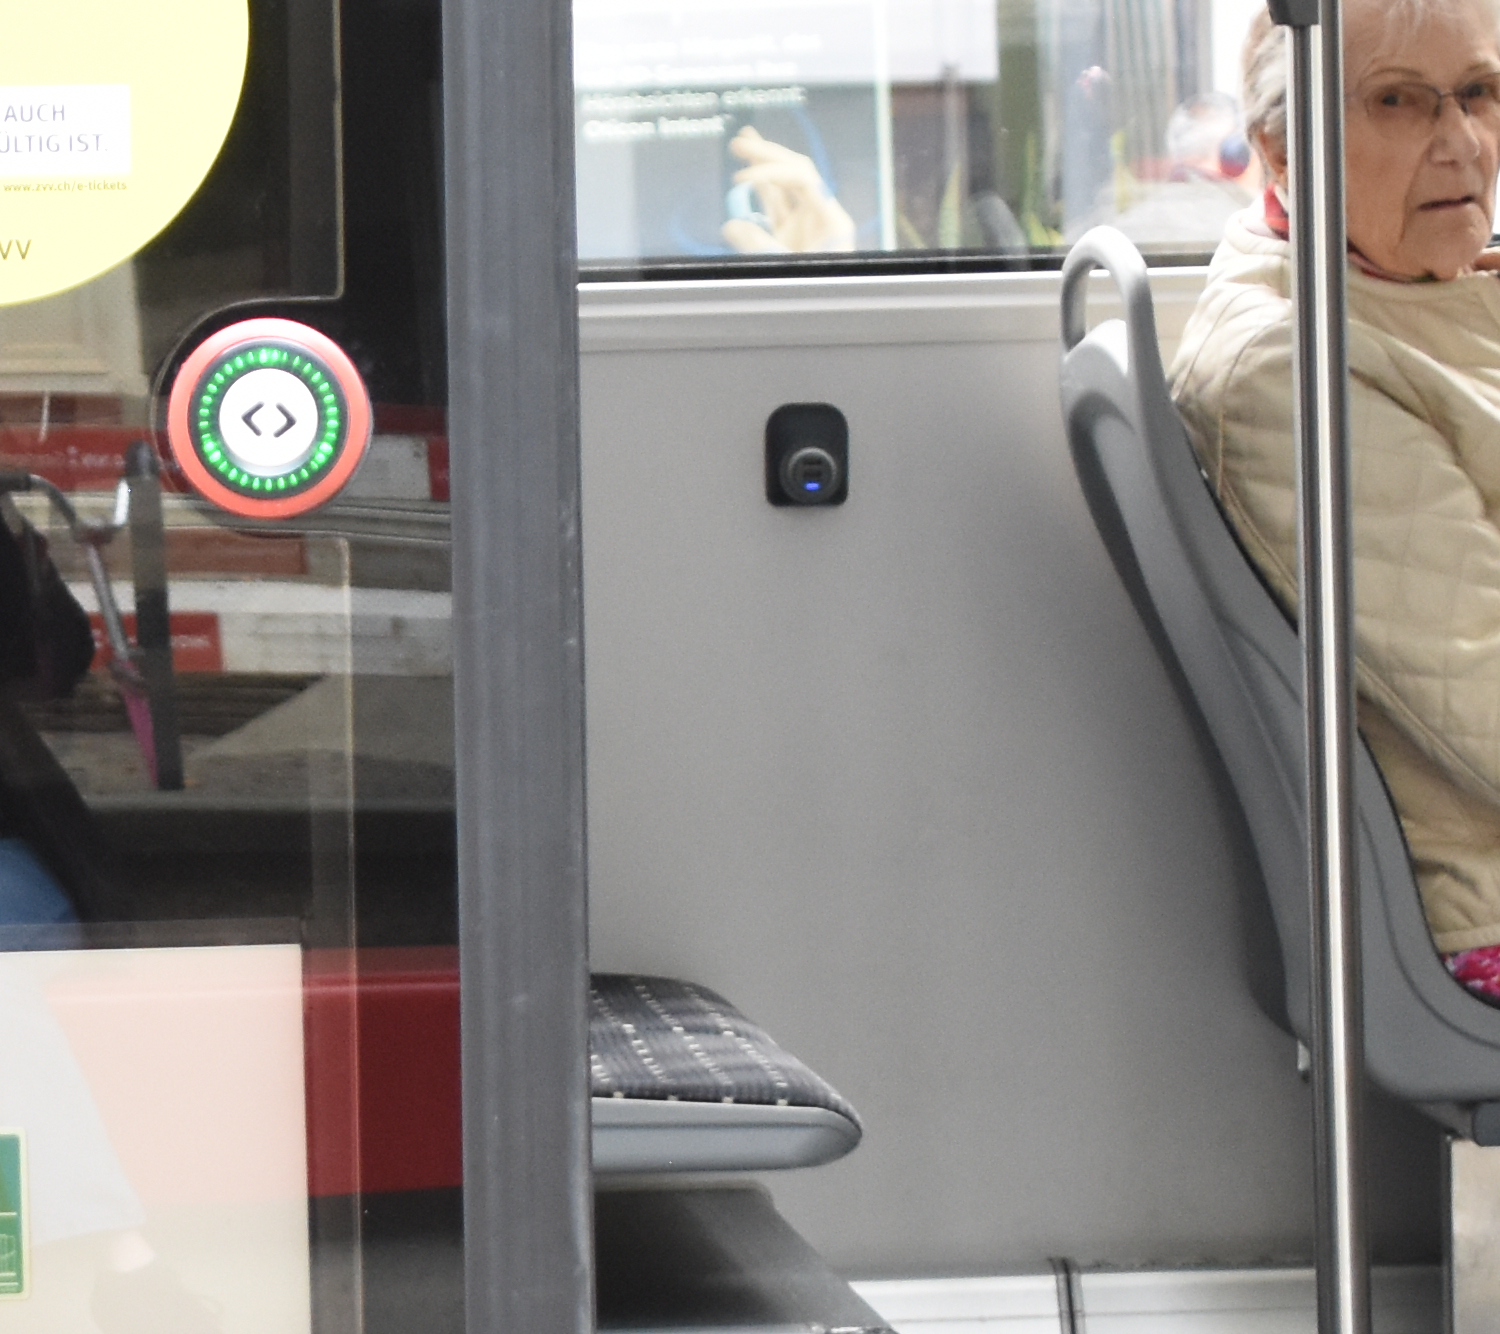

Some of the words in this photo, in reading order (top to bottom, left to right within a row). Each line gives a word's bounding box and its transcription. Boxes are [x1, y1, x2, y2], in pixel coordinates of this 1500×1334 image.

[4, 104, 65, 122] AUCH
[69, 134, 108, 152] IST.
[3, 180, 127, 192] www.zvv.ch/e-tickets
